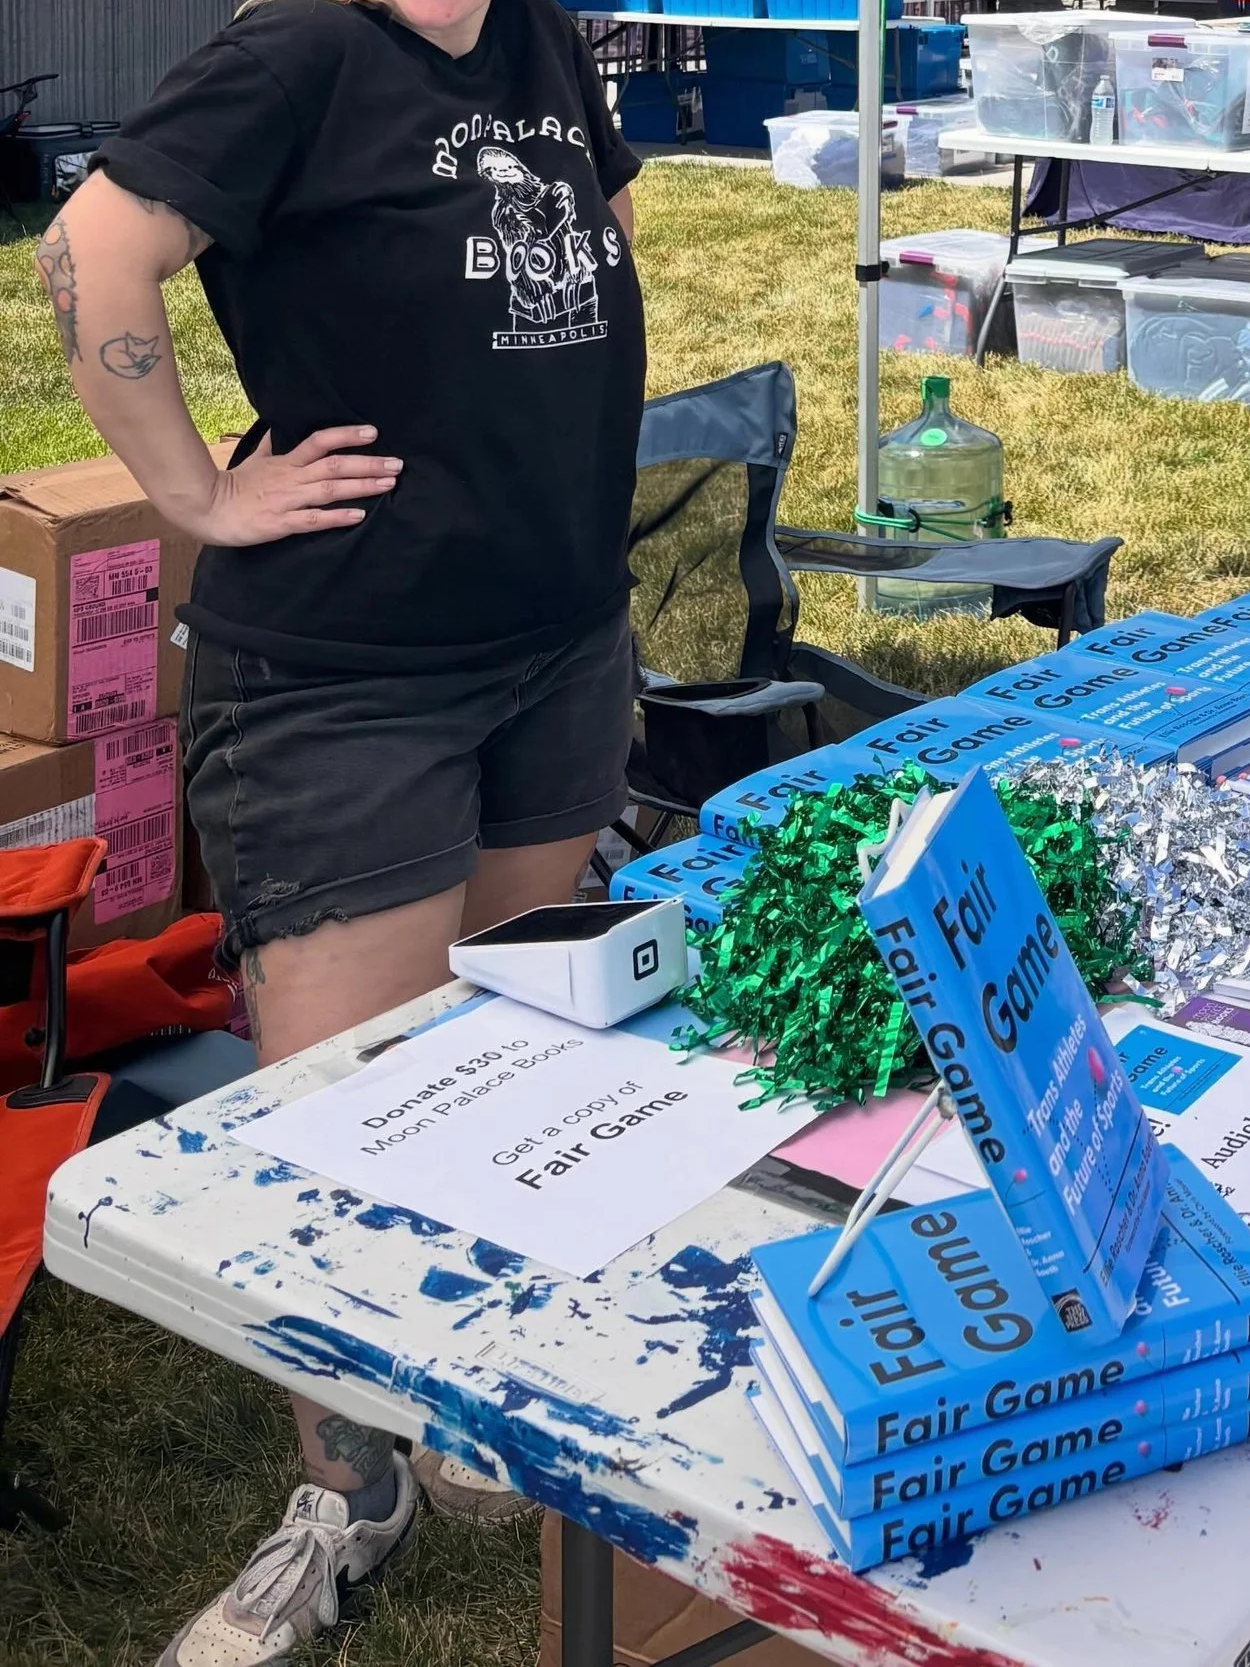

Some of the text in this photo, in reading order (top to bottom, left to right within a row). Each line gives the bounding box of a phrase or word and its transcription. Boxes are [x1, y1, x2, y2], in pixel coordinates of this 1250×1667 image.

[465, 226, 622, 281] BOOKS
[501, 324, 605, 345] MINNEAPOLIS
[1086, 625, 1157, 655] Fair
[1131, 625, 1228, 663] Game
[986, 668, 1062, 701] Fair
[1177, 656, 1213, 673] Trans
[1199, 654, 1241, 678] and the
[1213, 662, 1250, 682] Future
[1034, 666, 1140, 710] Game
[1082, 681, 1166, 720] Trans Athletes
[1118, 686, 1212, 729] Future of Sports
[866, 717, 950, 754] Fair
[1104, 701, 1150, 725] and the
[917, 716, 1032, 764] Game
[1005, 732, 1060, 758] Athletes
[736, 768, 830, 811] Fair
[649, 843, 745, 883] Fair
[931, 859, 997, 972] Fair
[981, 911, 1060, 1053] Game
[875, 916, 1005, 1164] Fair Game
[360, 1038, 585, 1157] Moon Palace Books
[361, 1038, 529, 1129] Donate $30 to
[1027, 1013, 1087, 1137] Trans Athletes
[492, 1080, 644, 1168] Get a copy of
[514, 1087, 689, 1190] Fair Game
[1050, 1098, 1083, 1176] and the
[1063, 1069, 1123, 1216] Future of Sports
[1181, 1203, 1196, 1220] Dr.
[1189, 1217, 1203, 1228] &
[1100, 1254, 1115, 1286] Ellie
[1110, 1220, 1131, 1256] Roscher
[1203, 1229, 1238, 1265] Roscher
[910, 1210, 1035, 1355] Game
[838, 1288, 947, 1387] Fair
[876, 1358, 1124, 1454] Fair Game
[873, 1417, 1123, 1510] Fair Game
[882, 1460, 1125, 1561] Fair Game
